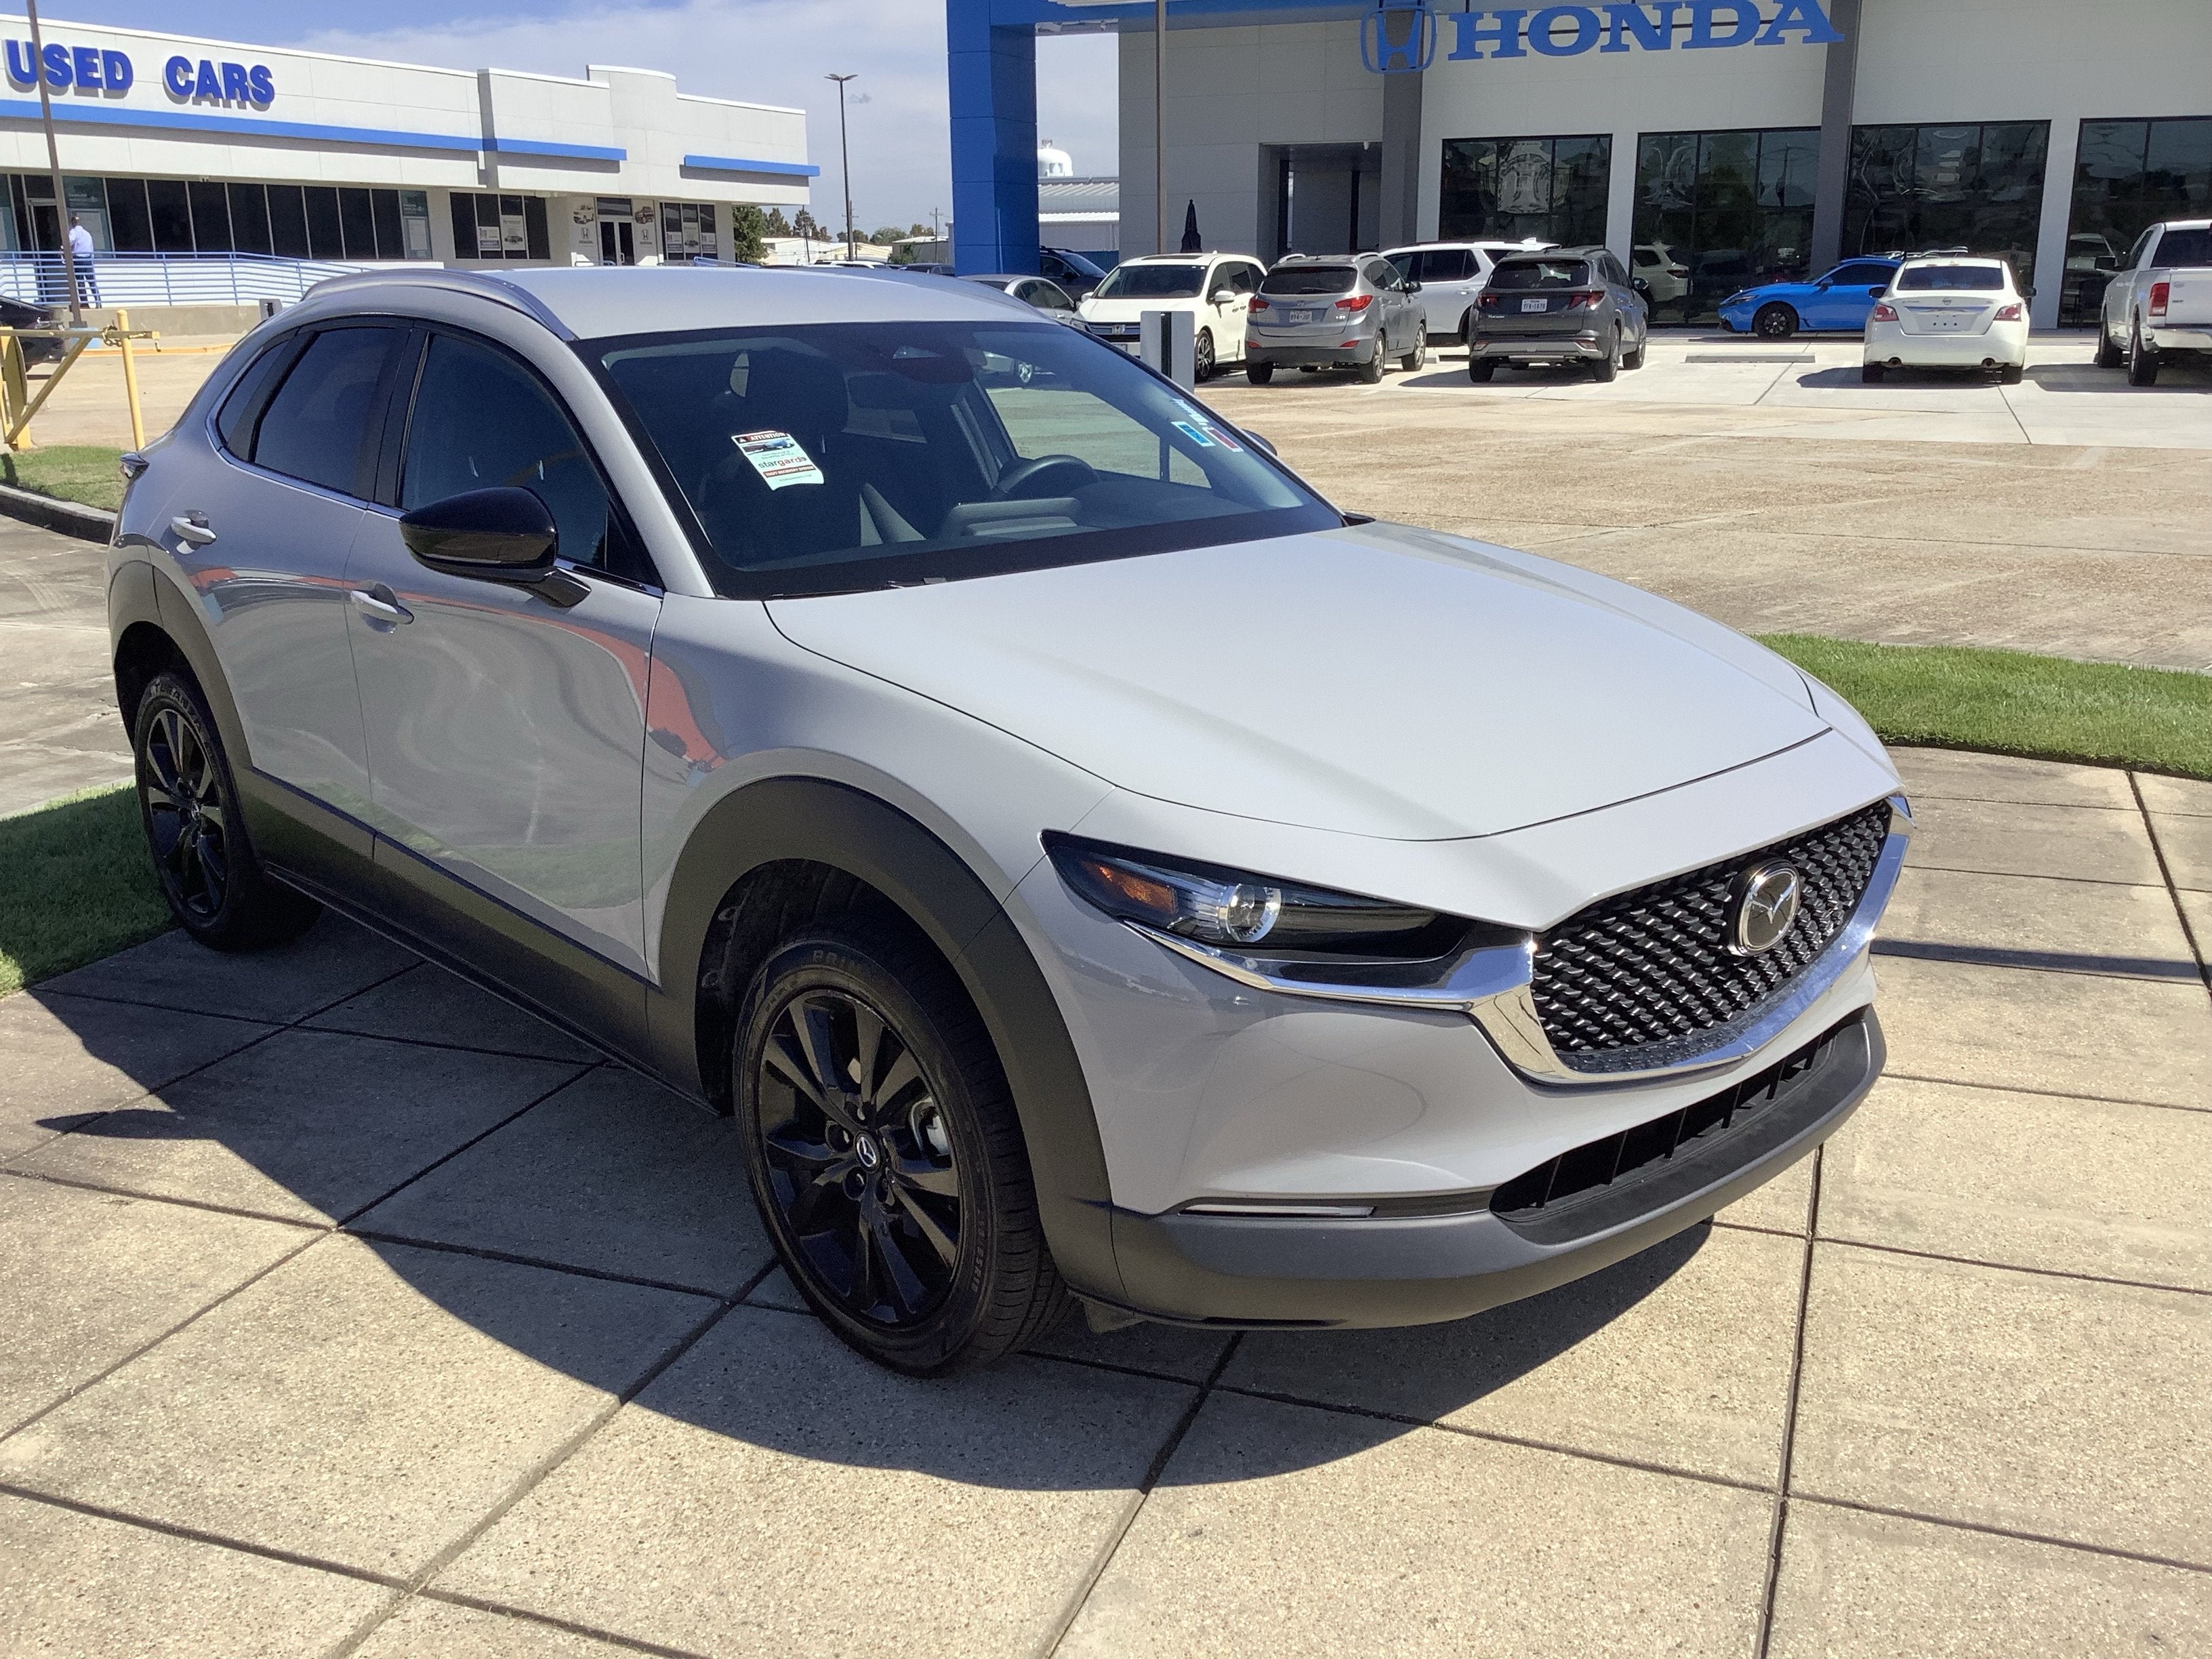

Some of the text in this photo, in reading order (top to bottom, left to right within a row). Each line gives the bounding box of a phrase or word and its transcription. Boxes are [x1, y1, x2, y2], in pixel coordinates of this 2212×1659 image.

[1448, 0, 1845, 61] HONDA
[3, 39, 275, 104] USED CARS
[750, 432, 786, 441] ATTENTION
